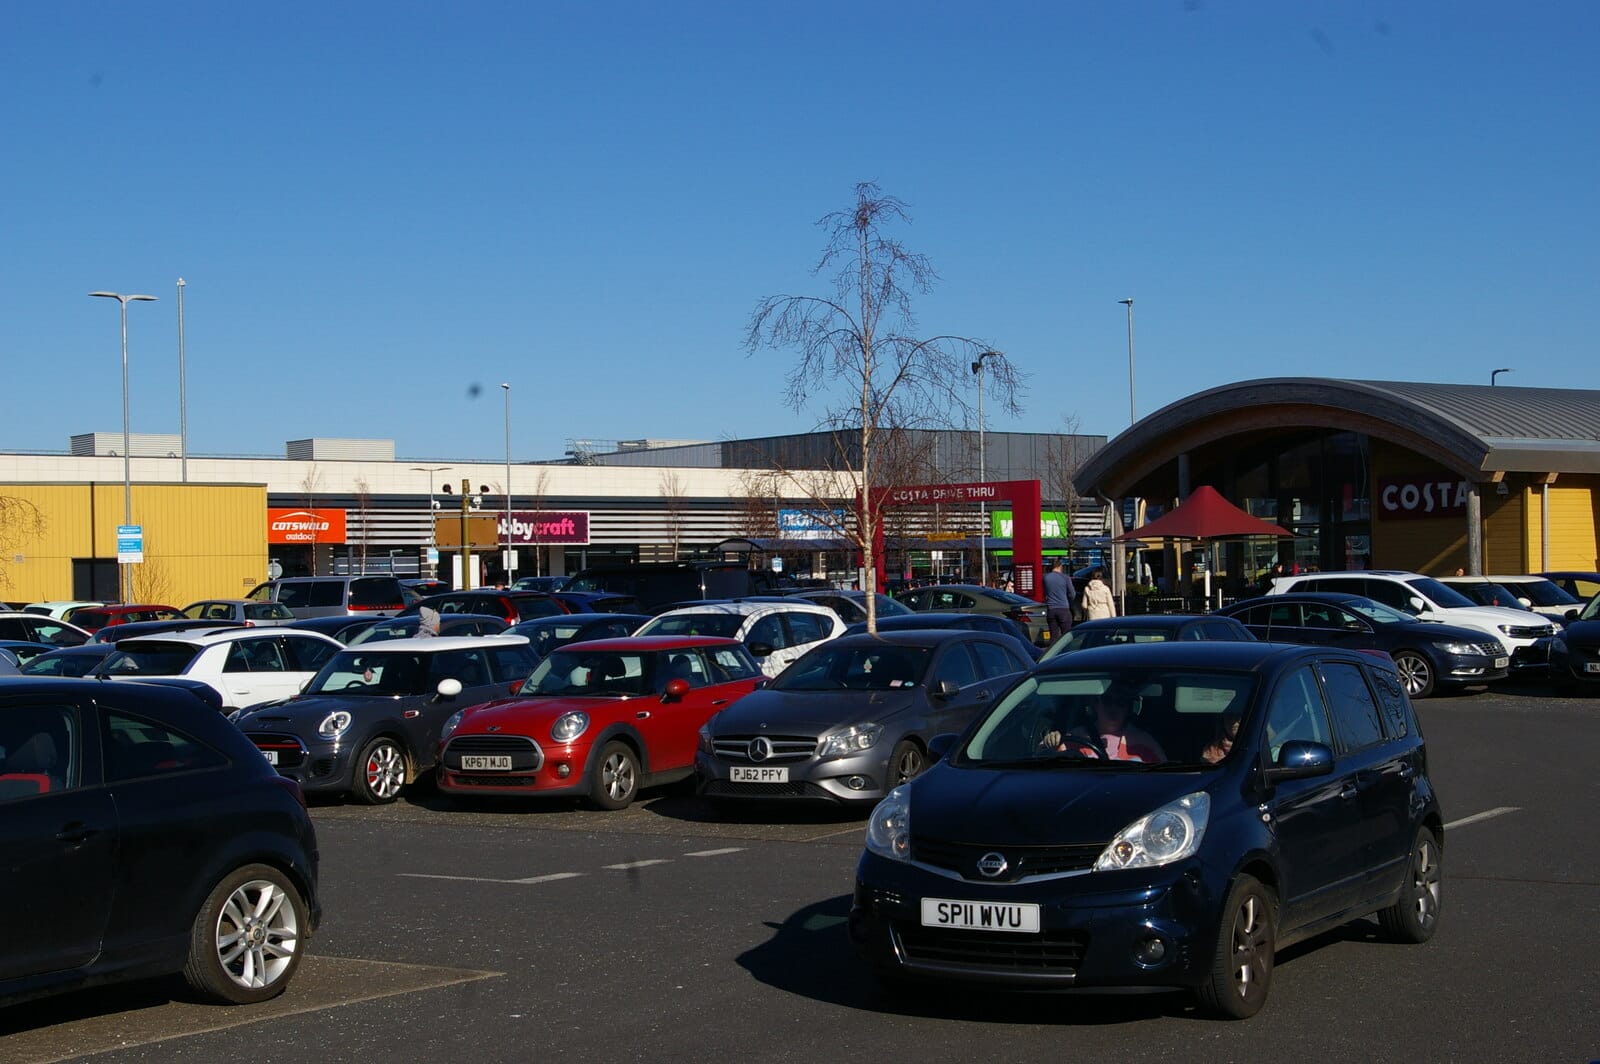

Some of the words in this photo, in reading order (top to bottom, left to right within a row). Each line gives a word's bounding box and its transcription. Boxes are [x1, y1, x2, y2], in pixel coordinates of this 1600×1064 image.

[892, 490, 929, 501] COSTA
[933, 488, 963, 499] DRIVE
[967, 486, 995, 498] THRU
[1382, 481, 1469, 512] COSTA
[272, 522, 329, 531] COTSWOLD
[464, 757, 488, 768] KP67
[734, 769, 759, 780] PJ62
[761, 769, 782, 780] PFY
[981, 905, 1021, 927] WVU
